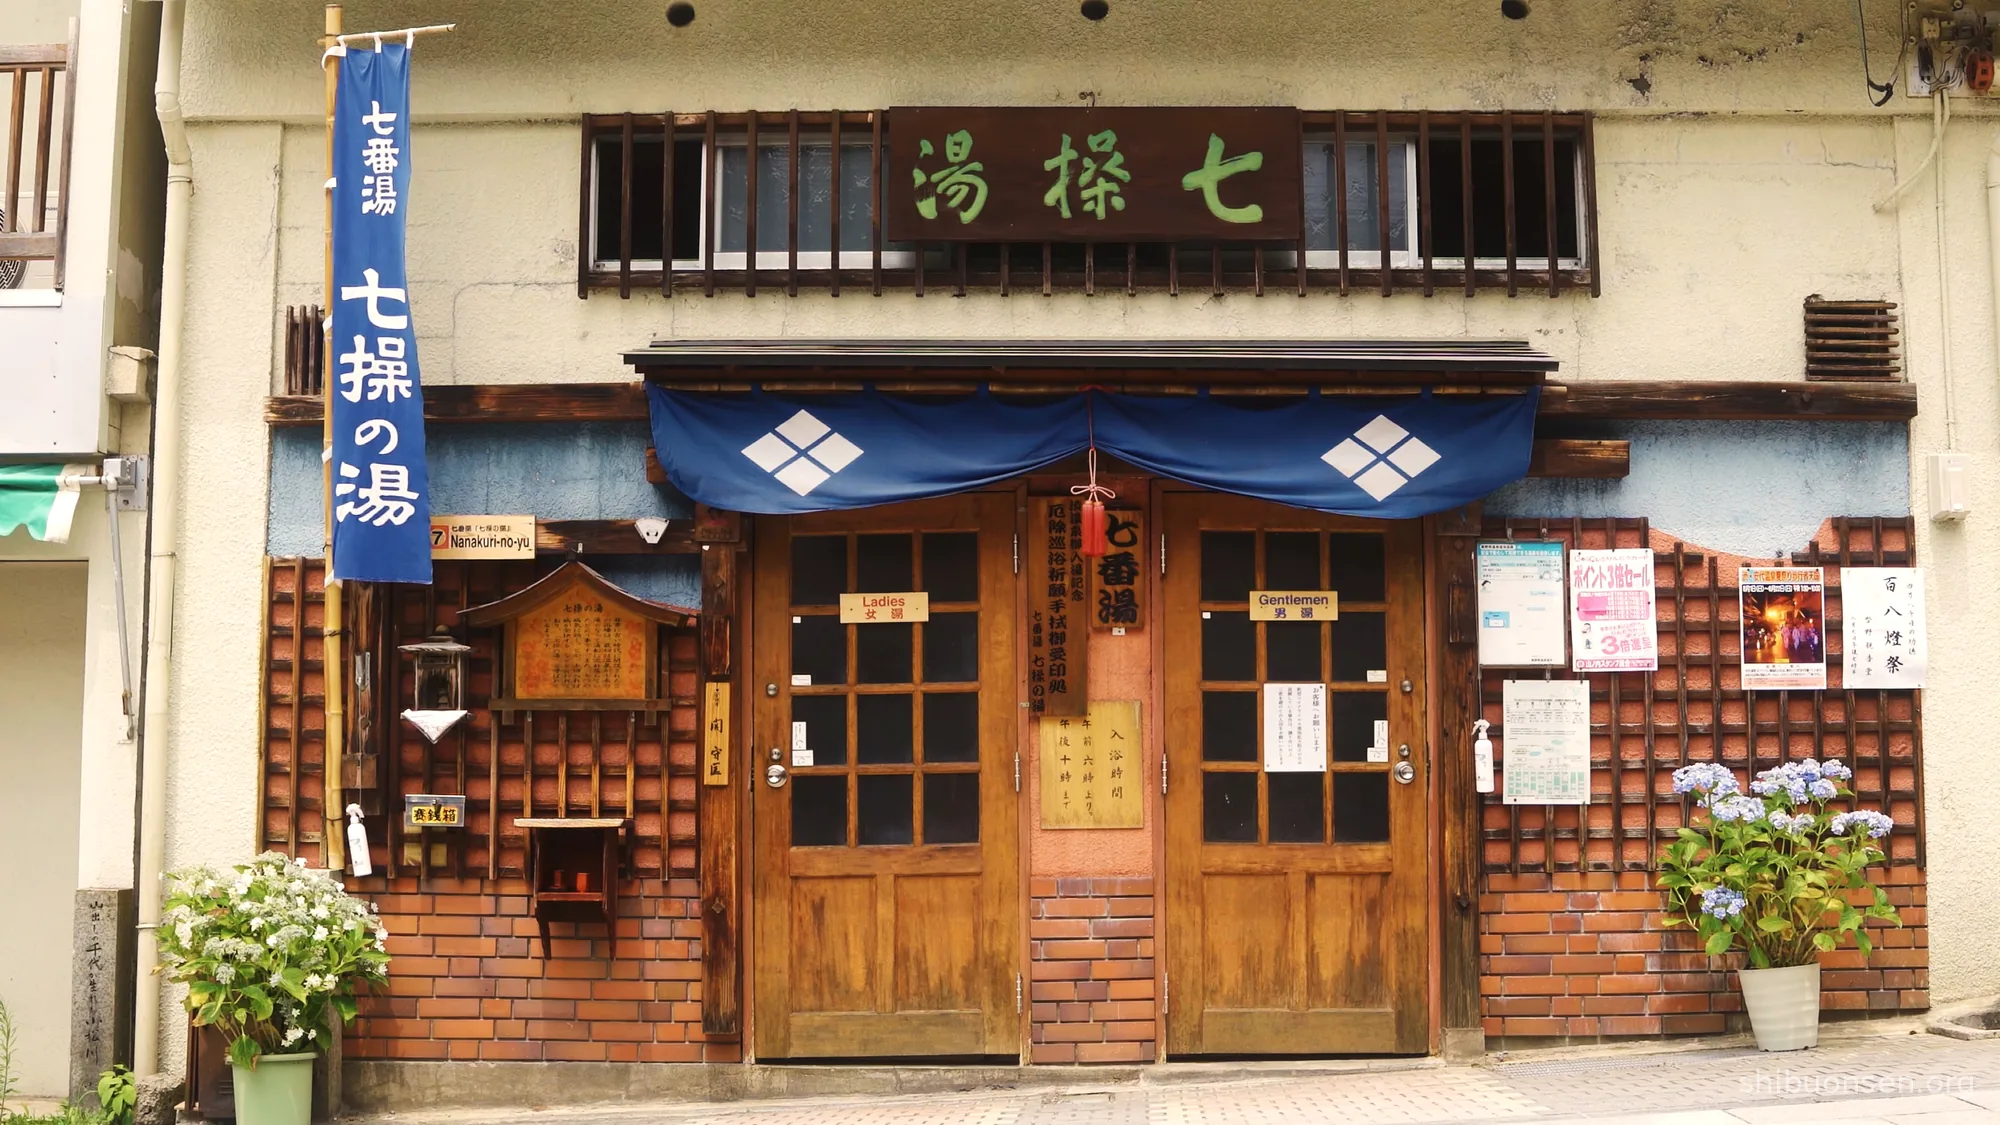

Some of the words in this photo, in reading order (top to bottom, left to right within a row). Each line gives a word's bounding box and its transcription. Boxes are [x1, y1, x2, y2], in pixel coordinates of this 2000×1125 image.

[362, 101, 399, 217] 七番湯
[336, 268, 420, 528] 七操の湯
[431, 531, 444, 546] 7
[450, 534, 530, 551] Nanakuri-no-yu
[1097, 512, 1140, 624] 七番湯
[862, 596, 905, 607] Ladies
[1258, 594, 1329, 606] Gentlemen
[1573, 563, 1651, 589] ポイント3倍セール
[1882, 576, 1904, 675] 百八燈祭
[1312, 687, 1320, 752] お客様へお願いします
[1059, 719, 1072, 810] 午後十時まで
[1109, 729, 1124, 799] 入浴時間
